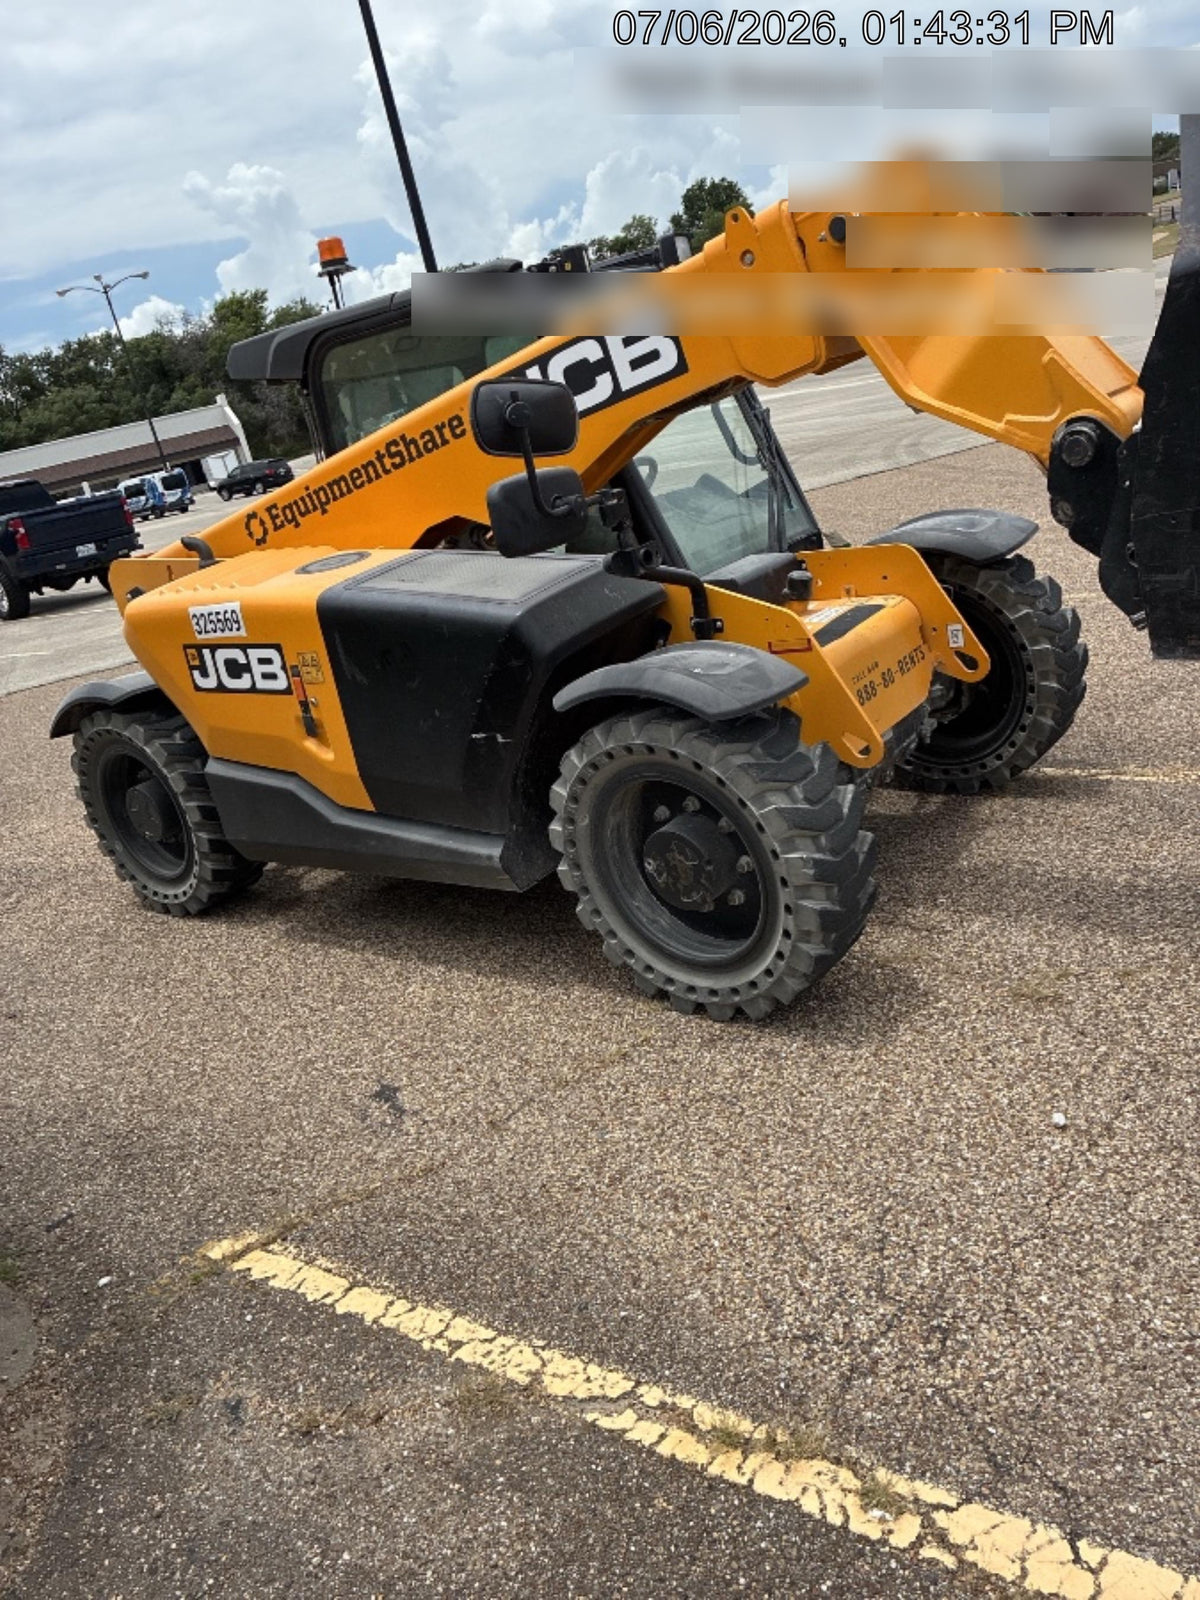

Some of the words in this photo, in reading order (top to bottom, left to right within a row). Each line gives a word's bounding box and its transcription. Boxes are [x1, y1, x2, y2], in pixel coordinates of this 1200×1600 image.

[526, 336, 678, 411] CB
[266, 413, 467, 532] EquipmentShare
[192, 609, 241, 635] 325569
[192, 648, 288, 690] JCB
